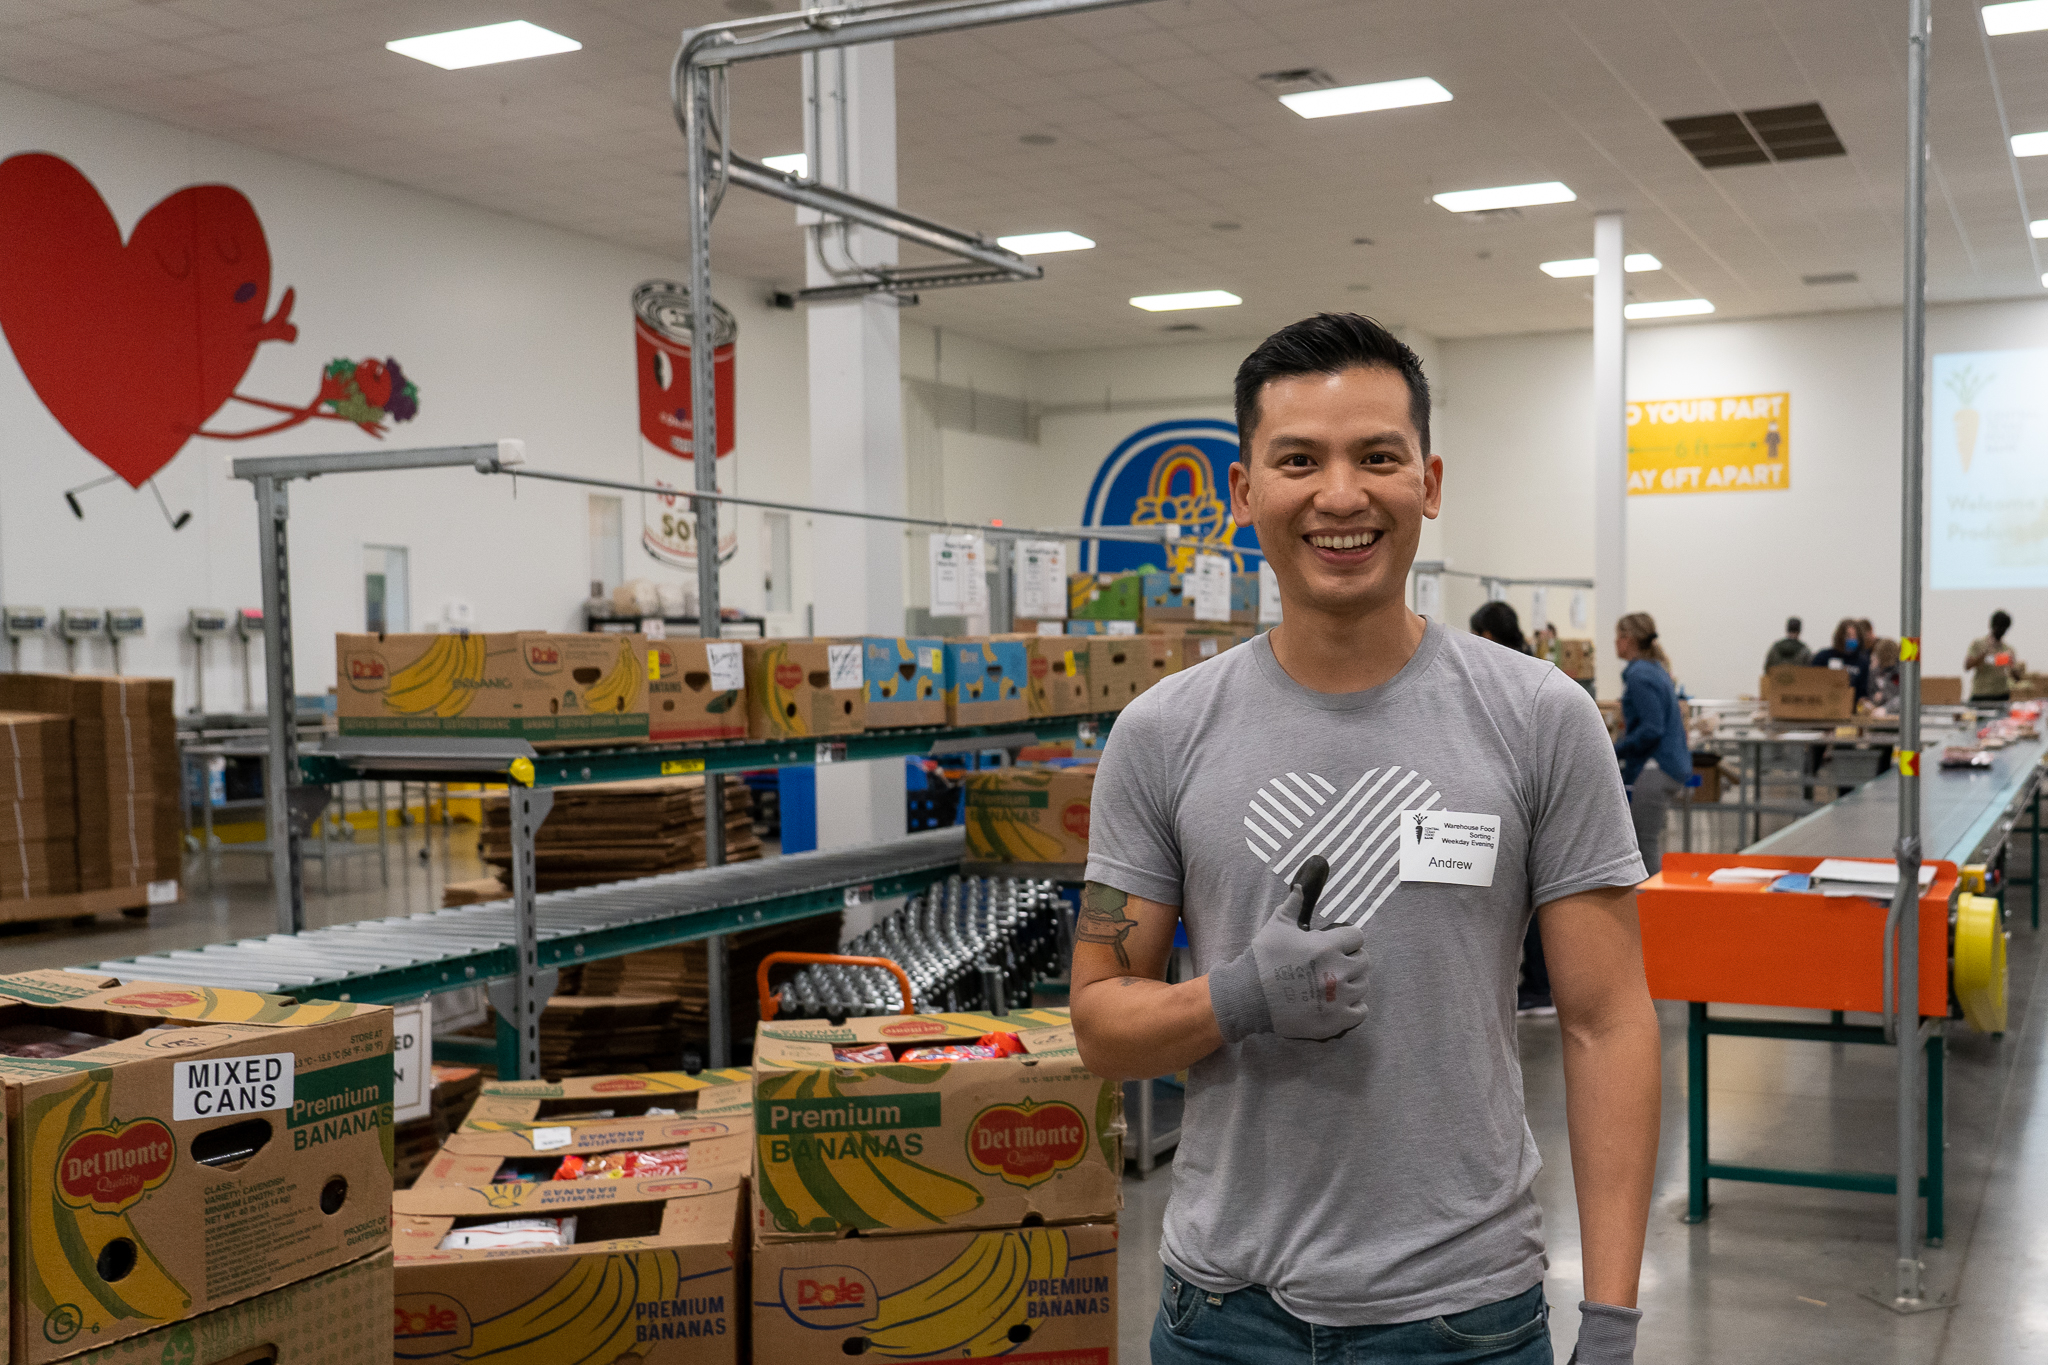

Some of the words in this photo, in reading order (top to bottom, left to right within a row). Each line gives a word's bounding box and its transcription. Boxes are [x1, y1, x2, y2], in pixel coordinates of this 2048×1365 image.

[1645, 400, 1717, 425] YOUR
[1721, 396, 1783, 421] PART
[1627, 469, 1657, 490] AY
[1661, 466, 1701, 489] 6FT
[1705, 463, 1783, 487] APART
[662, 513, 697, 541] SO
[1443, 822, 1479, 831] Warehouse
[1469, 832, 1491, 841] Sorting
[1441, 838, 1470, 846] Weekday
[1471, 840, 1495, 849] Evening
[1428, 857, 1473, 870] Andrew
[350, 1031, 374, 1044] STORE
[374, 1029, 384, 1039] AT
[188, 1058, 282, 1089] MIXED
[194, 1084, 276, 1115] CANS
[293, 1085, 380, 1121] Premium
[294, 1105, 393, 1151] BANANAS
[770, 1102, 901, 1129] Premium
[770, 1133, 924, 1164] BANANAS
[978, 1127, 1012, 1150] Del
[1014, 1124, 1081, 1148] Monte
[68, 1153, 101, 1181] Del
[103, 1141, 169, 1173] Monte
[344, 1218, 376, 1237] PRODUCT
[377, 1215, 388, 1225] OF
[346, 1225, 388, 1247] GUATEMALA
[797, 1277, 866, 1307] Dole
[1026, 1277, 1109, 1298] PREMIUM
[635, 1296, 725, 1321] PREMIUM
[1026, 1296, 1110, 1319] BANANAS
[635, 1318, 727, 1343] BANANAS
